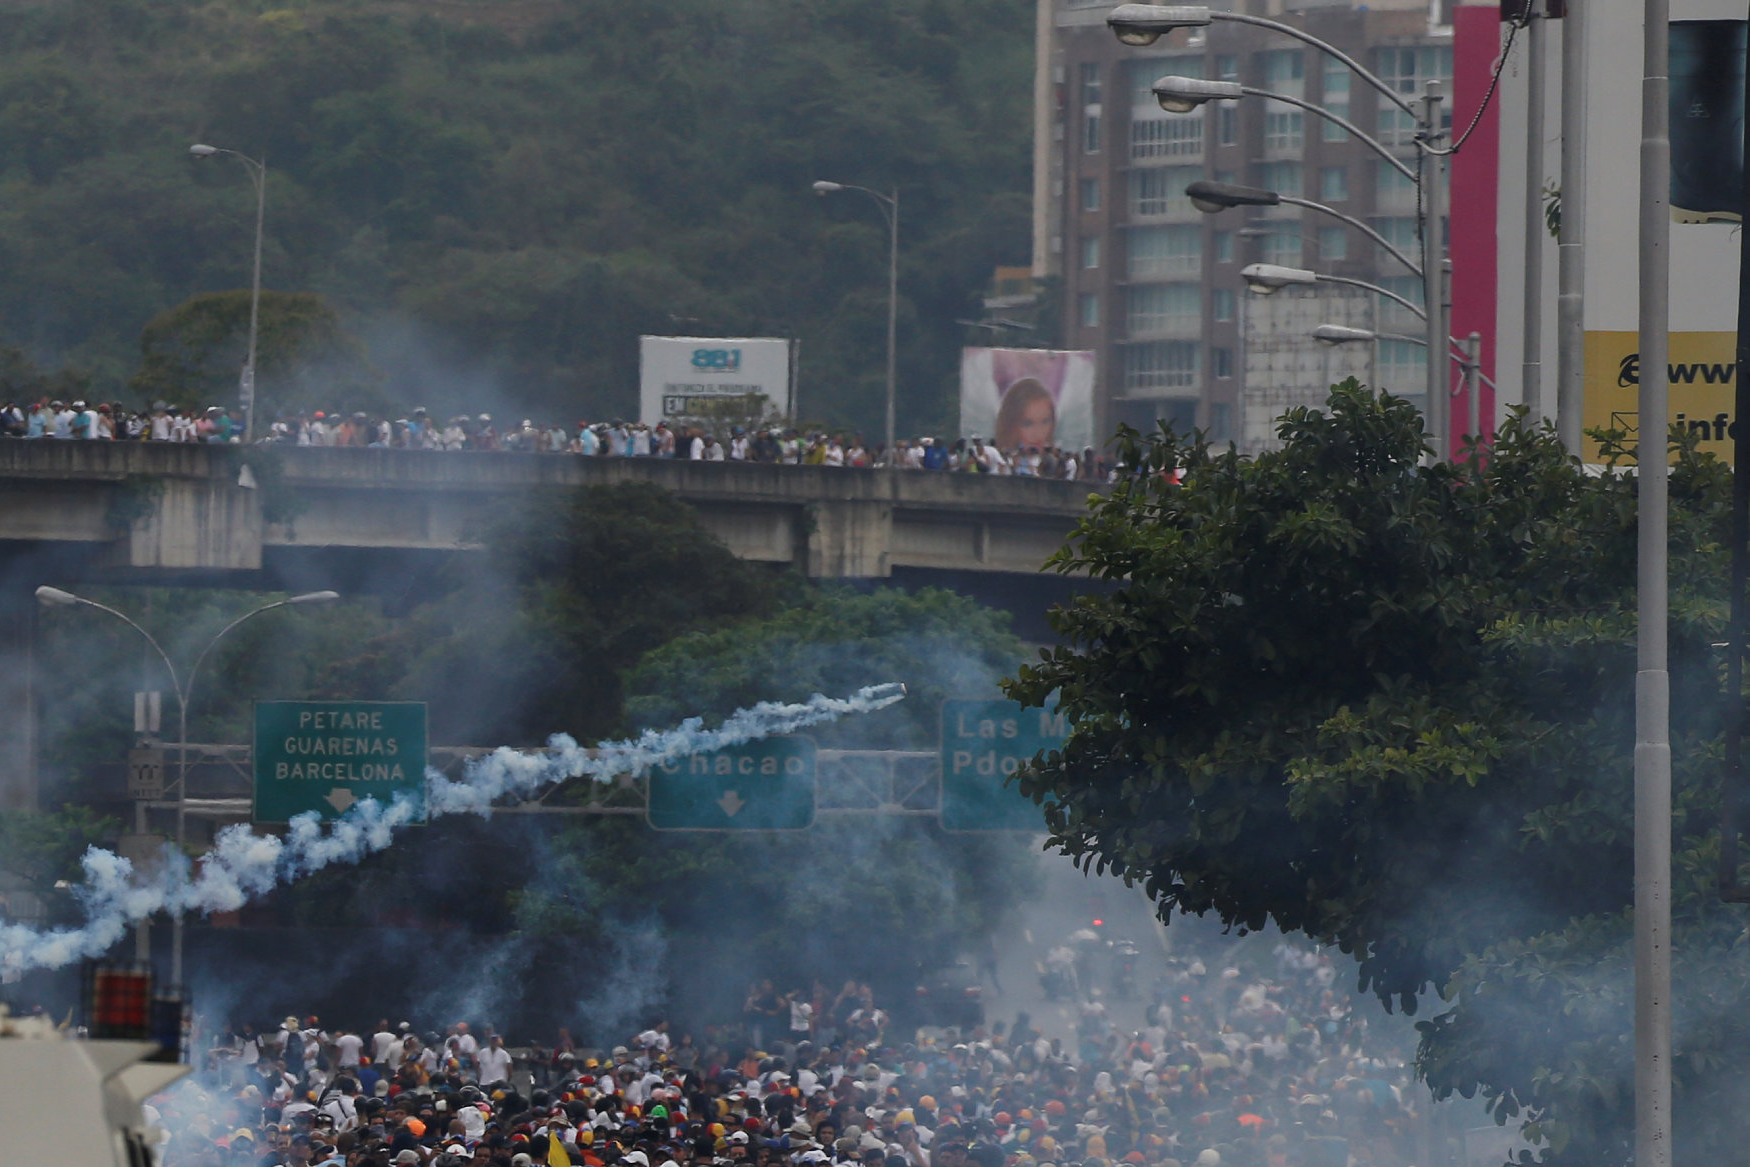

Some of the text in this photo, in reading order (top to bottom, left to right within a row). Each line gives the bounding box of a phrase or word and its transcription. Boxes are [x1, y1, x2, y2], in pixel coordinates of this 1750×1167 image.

[299, 711, 383, 730] PETARE
[957, 711, 1067, 739] Las M
[284, 737, 399, 756] GUARENAS
[275, 762, 405, 781] BARCELONA
[660, 752, 805, 775] Chacao
